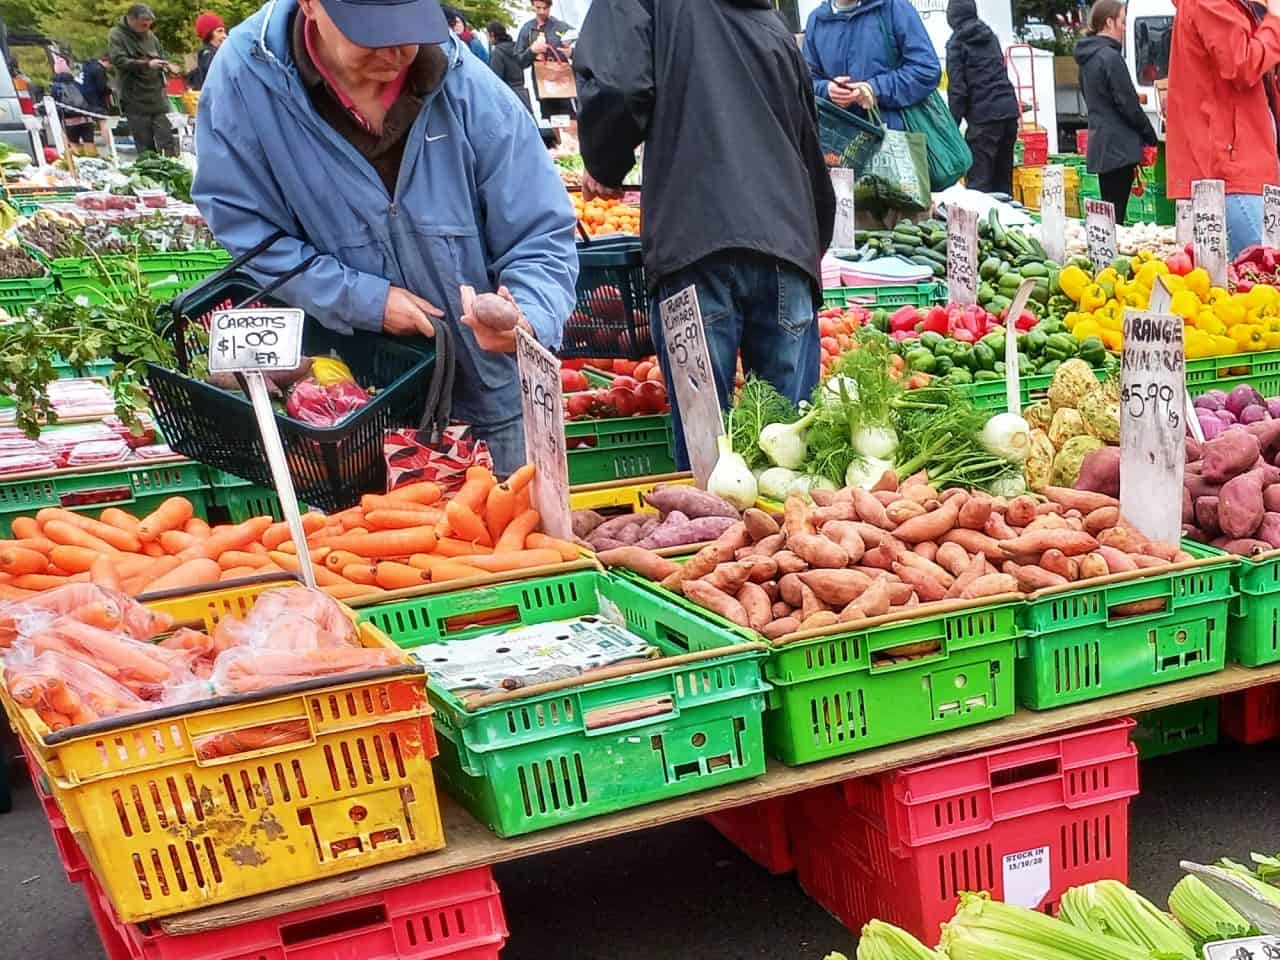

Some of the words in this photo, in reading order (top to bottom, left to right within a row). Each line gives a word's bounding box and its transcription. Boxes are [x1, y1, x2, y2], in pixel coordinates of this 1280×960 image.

[217, 314, 286, 330] CARROTS
[1122, 317, 1183, 344] ORANGE
[255, 351, 280, 366] EA
[1005, 850, 1034, 862] STOCK
[1034, 848, 1045, 856] IN
